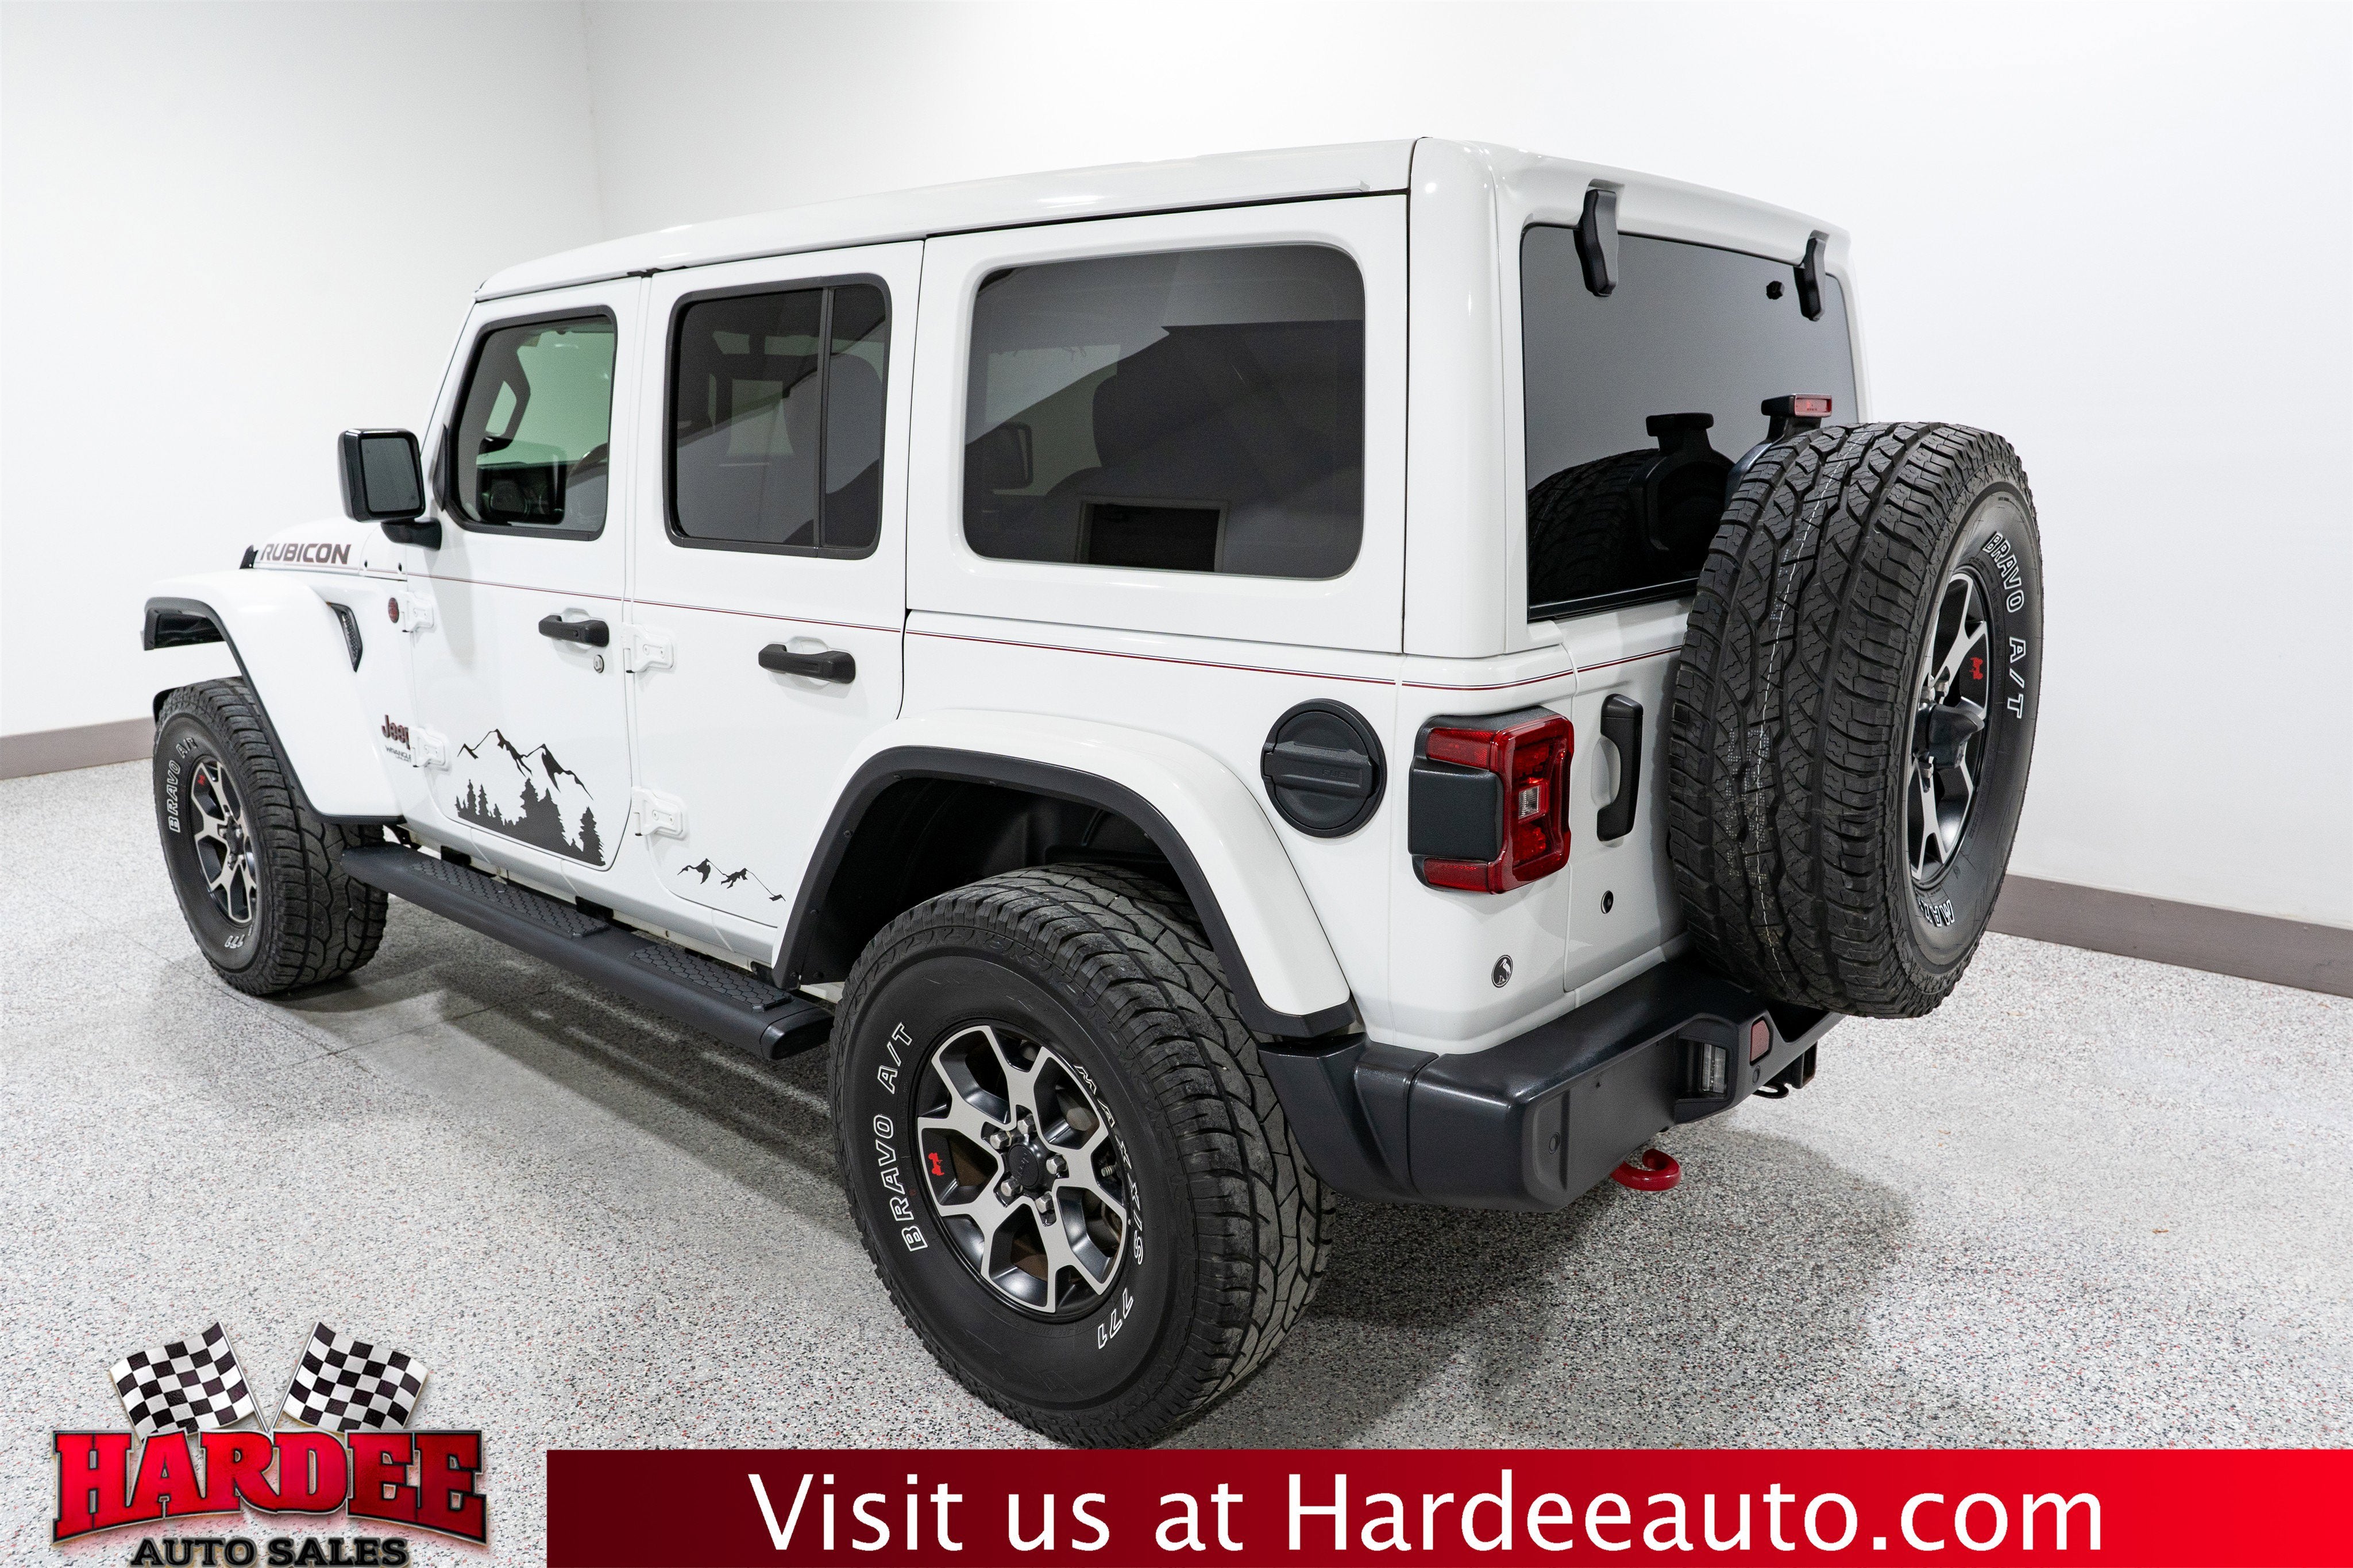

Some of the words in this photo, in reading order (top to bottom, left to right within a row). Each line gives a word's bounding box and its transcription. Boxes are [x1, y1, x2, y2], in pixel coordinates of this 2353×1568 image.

[260, 543, 352, 565] RUBICON
[1982, 531, 2025, 613] BRAVO
[2007, 636, 2027, 719] A/T
[162, 759, 182, 833] BRAVO
[175, 737, 199, 759] A/T
[877, 1021, 913, 1095] A/T
[873, 1113, 929, 1252] BRAVO
[1073, 1064, 1143, 1265] MAXXIS
[1098, 1287, 1134, 1350] 771
